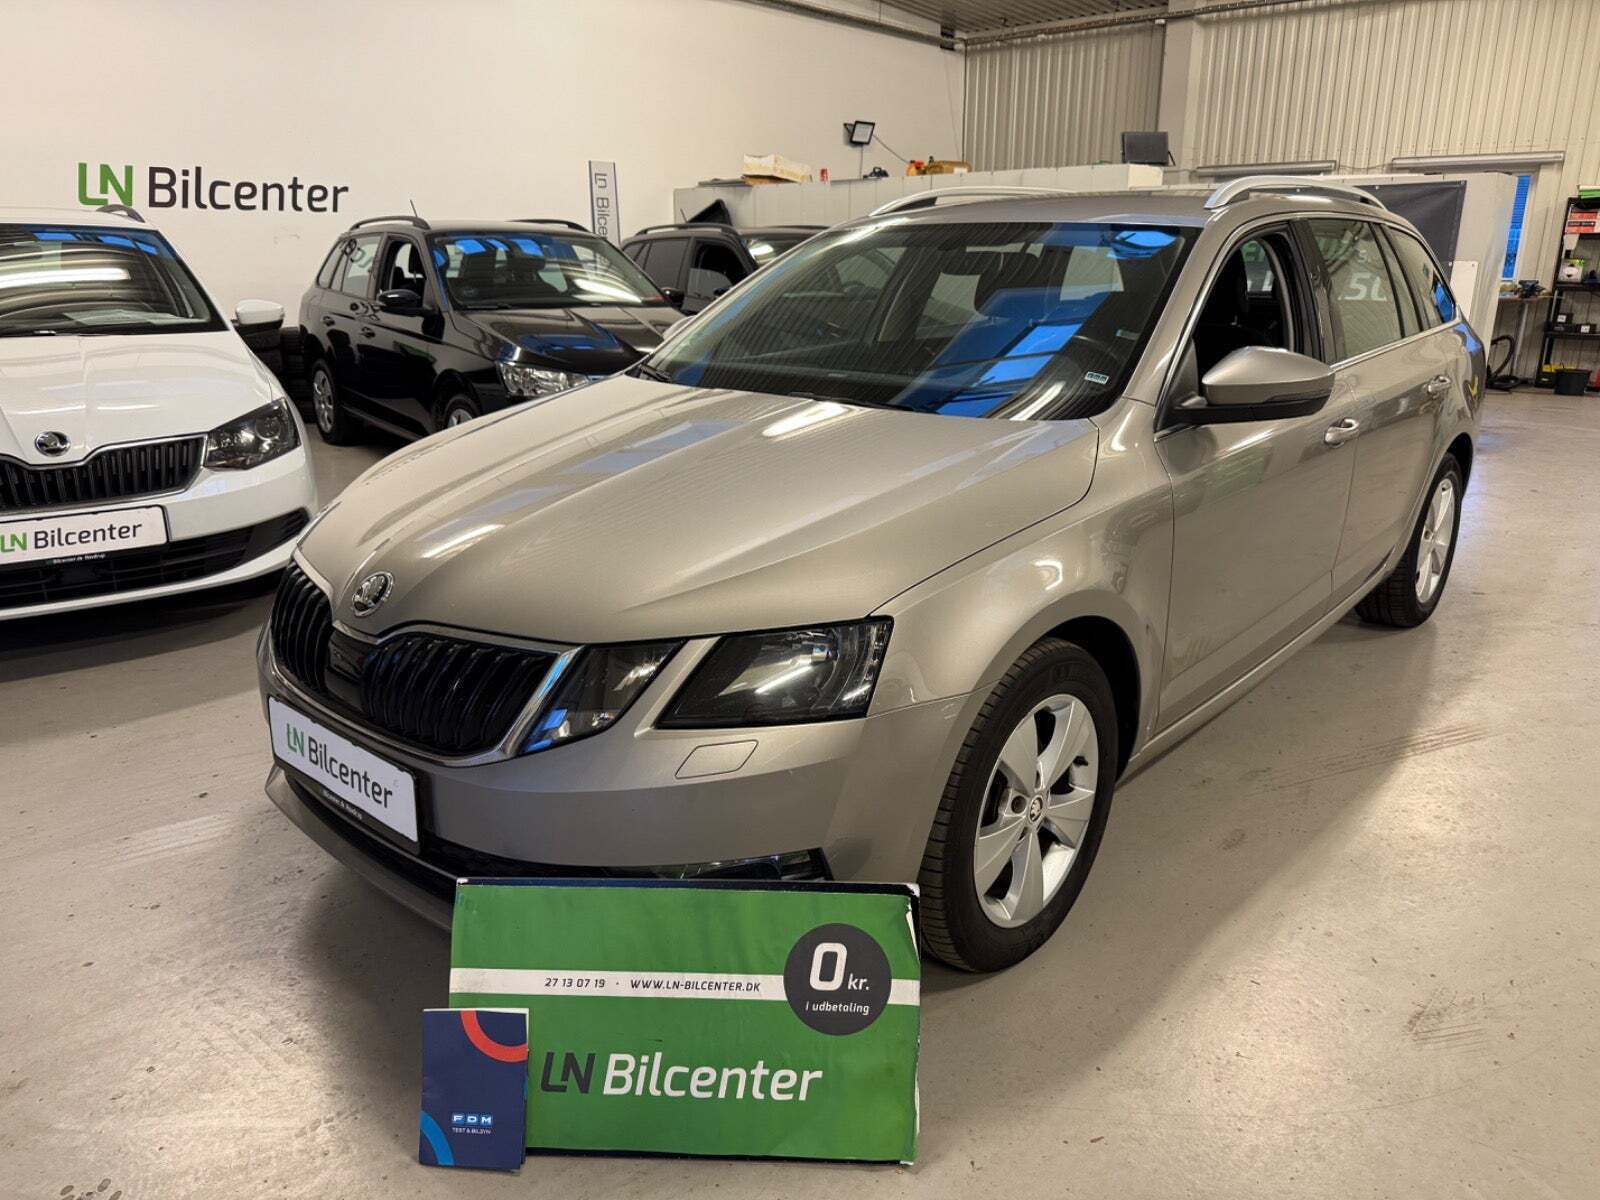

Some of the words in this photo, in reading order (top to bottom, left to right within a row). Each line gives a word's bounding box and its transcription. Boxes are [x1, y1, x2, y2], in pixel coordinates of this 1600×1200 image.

[78, 162, 133, 206] LN
[148, 166, 349, 212] Bilcenter
[0, 532, 28, 552] LN
[34, 523, 142, 549] Bilcenter
[286, 723, 305, 757] LN
[308, 736, 393, 809] Bilcenter
[544, 977, 558, 988] 27
[562, 978, 573, 988] 13
[576, 978, 590, 988] 07
[594, 978, 606, 989] 19
[630, 978, 761, 993] WWW.LN-BILCENTER.DK
[809, 942, 848, 991] 0
[847, 973, 870, 991] kr.
[812, 1000, 870, 1016] udbetaling
[540, 1051, 596, 1095] LN
[603, 1051, 823, 1101] Bilcenter
[453, 1115, 492, 1125] FDM
